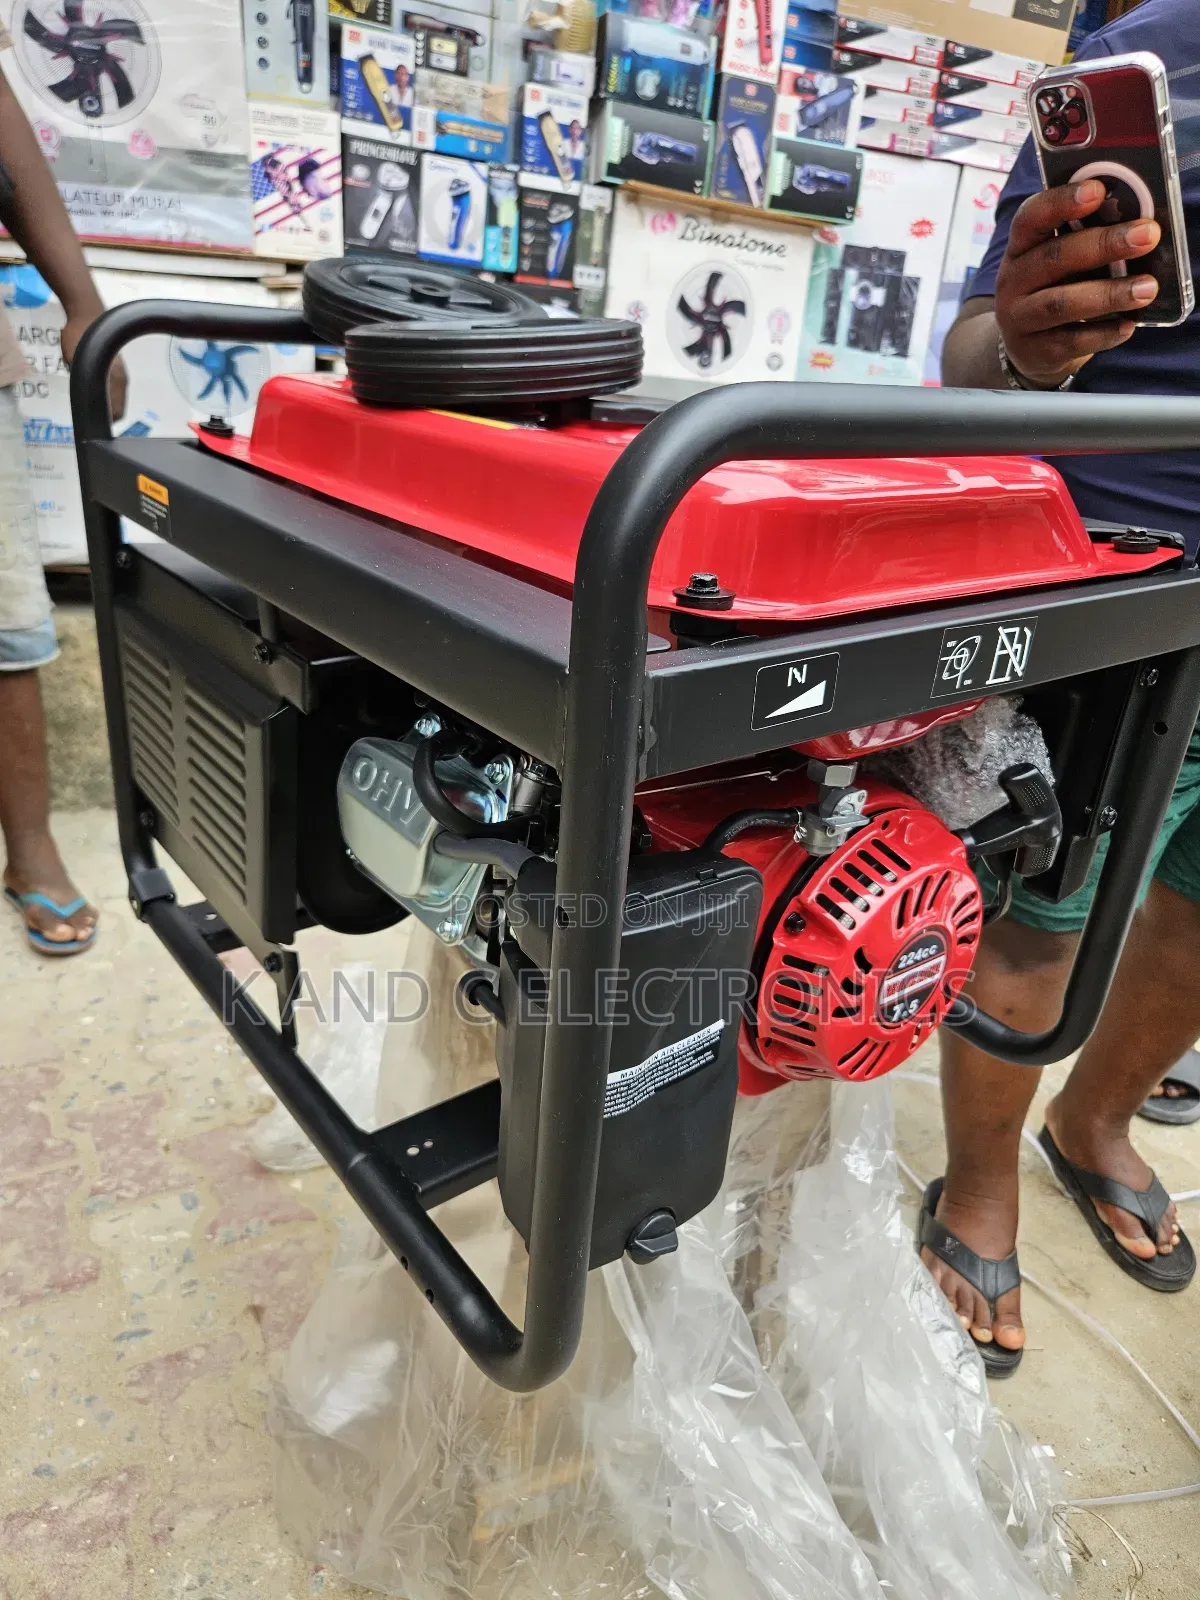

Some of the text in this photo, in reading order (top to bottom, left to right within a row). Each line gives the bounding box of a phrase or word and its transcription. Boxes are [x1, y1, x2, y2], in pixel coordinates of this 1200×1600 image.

[678, 213, 788, 258] Binatone
[787, 664, 808, 688] N
[352, 755, 424, 825] OHV
[891, 998, 920, 1023] 7.5
[620, 1028, 712, 1080] MAINTAIN AIR CLEANER
